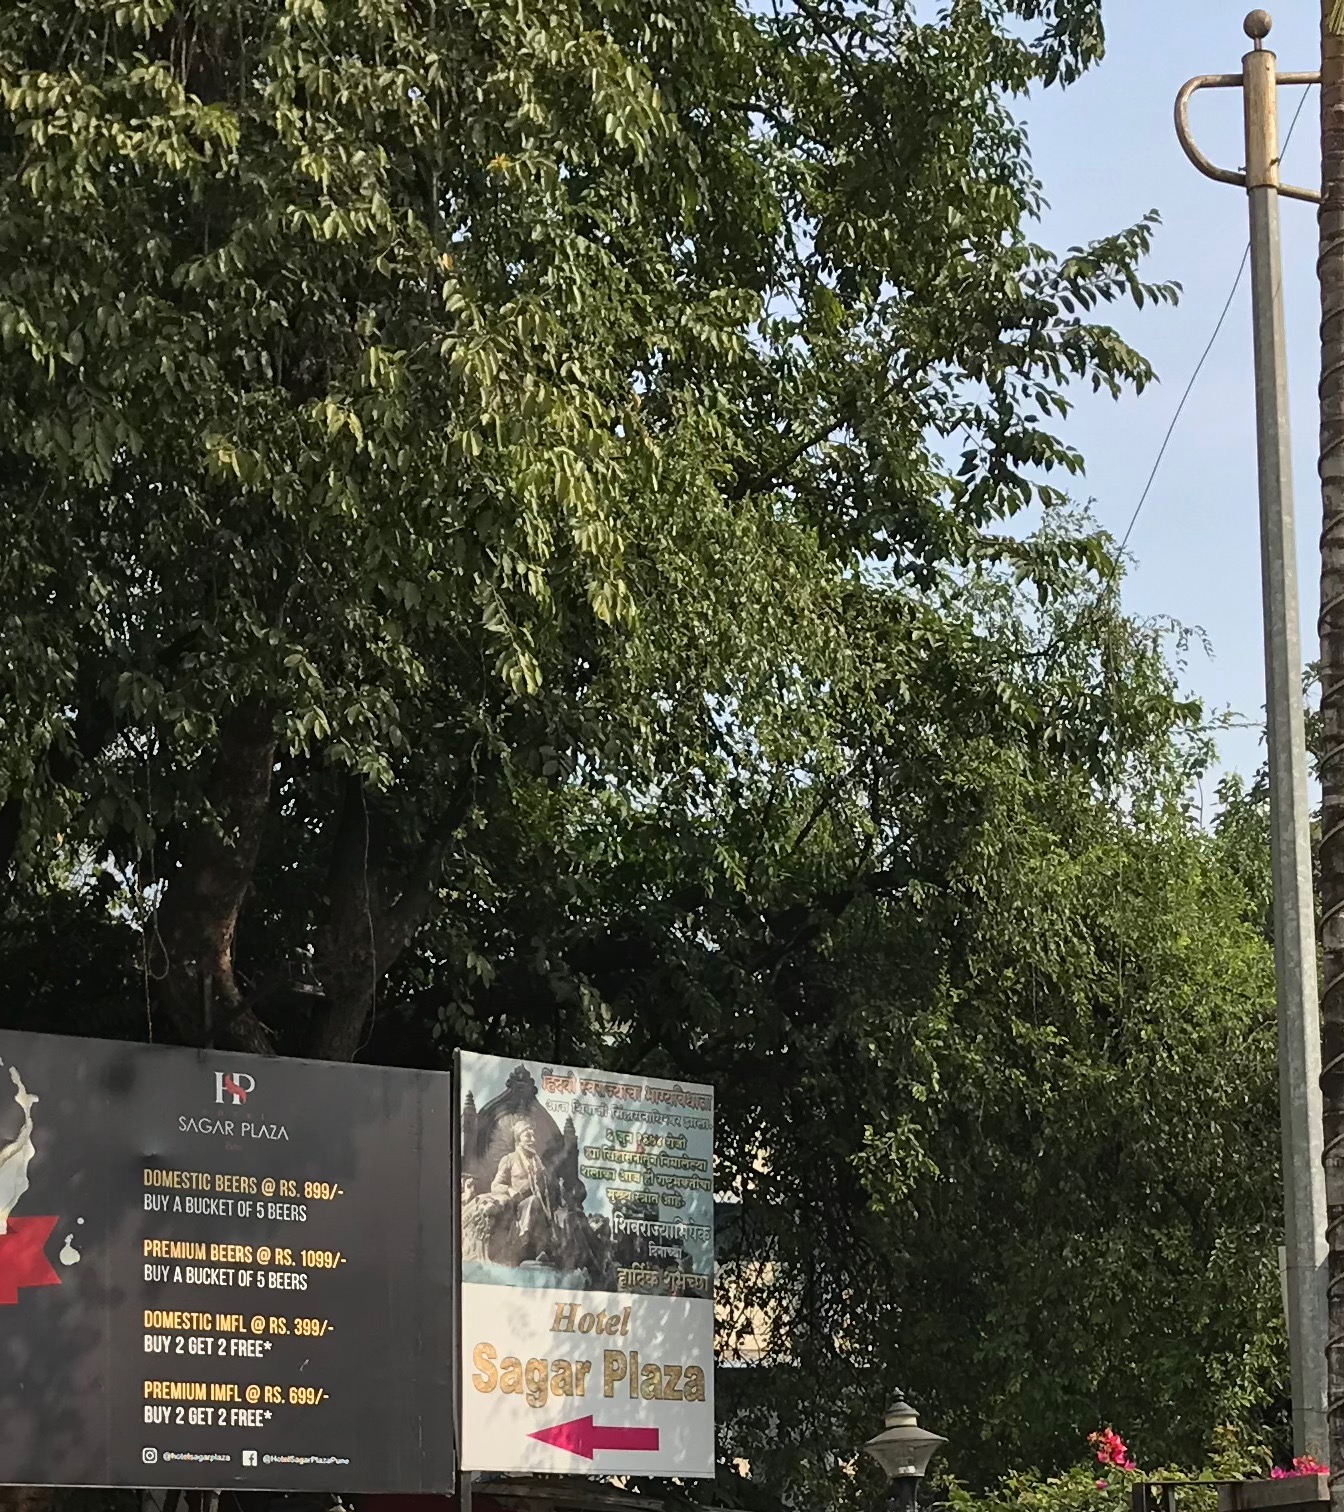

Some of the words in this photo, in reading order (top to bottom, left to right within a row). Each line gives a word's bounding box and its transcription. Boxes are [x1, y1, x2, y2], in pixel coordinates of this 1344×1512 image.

[179, 1116, 234, 1136] SAGAR
[241, 1123, 289, 1140] PLAZA
[144, 1169, 211, 1190] DOMESTIC
[215, 1175, 257, 1194] BEERS
[261, 1178, 275, 1196] @
[280, 1179, 301, 1197] RS.
[304, 1181, 344, 1200] 899/-
[144, 1193, 169, 1211] BUY
[173, 1196, 182, 1213] A
[186, 1197, 234, 1216] BUCKET
[237, 1200, 255, 1217] OF
[256, 1202, 265, 1218] 5
[268, 1202, 307, 1222] BEERS
[144, 1239, 206, 1260] PREMIUM
[211, 1244, 253, 1263] BEERS
[257, 1247, 271, 1265] @
[275, 1248, 296, 1266] RS.
[301, 1250, 347, 1269] 1099/-
[144, 1264, 170, 1282] BUY
[173, 1266, 182, 1283] A
[186, 1266, 235, 1286] BUCKET
[238, 1270, 253, 1287] OF
[257, 1271, 265, 1288] 5
[268, 1272, 308, 1291] BEERS
[144, 1310, 212, 1331] DOMESTIC
[216, 1314, 247, 1333] IMFL
[251, 1315, 266, 1334] @
[269, 1317, 290, 1335] RS.
[294, 1318, 334, 1336] 399/-
[549, 1302, 632, 1336] Hotel
[144, 1335, 171, 1353] BUY
[175, 1336, 184, 1354] 2
[188, 1337, 214, 1355] GET
[218, 1339, 226, 1356] 2
[471, 1342, 592, 1408] Sagar
[603, 1349, 706, 1402] Plaza
[144, 1381, 206, 1400] PREMIUM
[211, 1384, 242, 1402] IMFL
[246, 1384, 260, 1403] @
[265, 1386, 285, 1404] RS.
[289, 1387, 329, 1405] 699/-
[144, 1406, 171, 1424] BUY
[175, 1407, 184, 1424] 2
[188, 1408, 214, 1425] GET
[218, 1409, 226, 1426] 2
